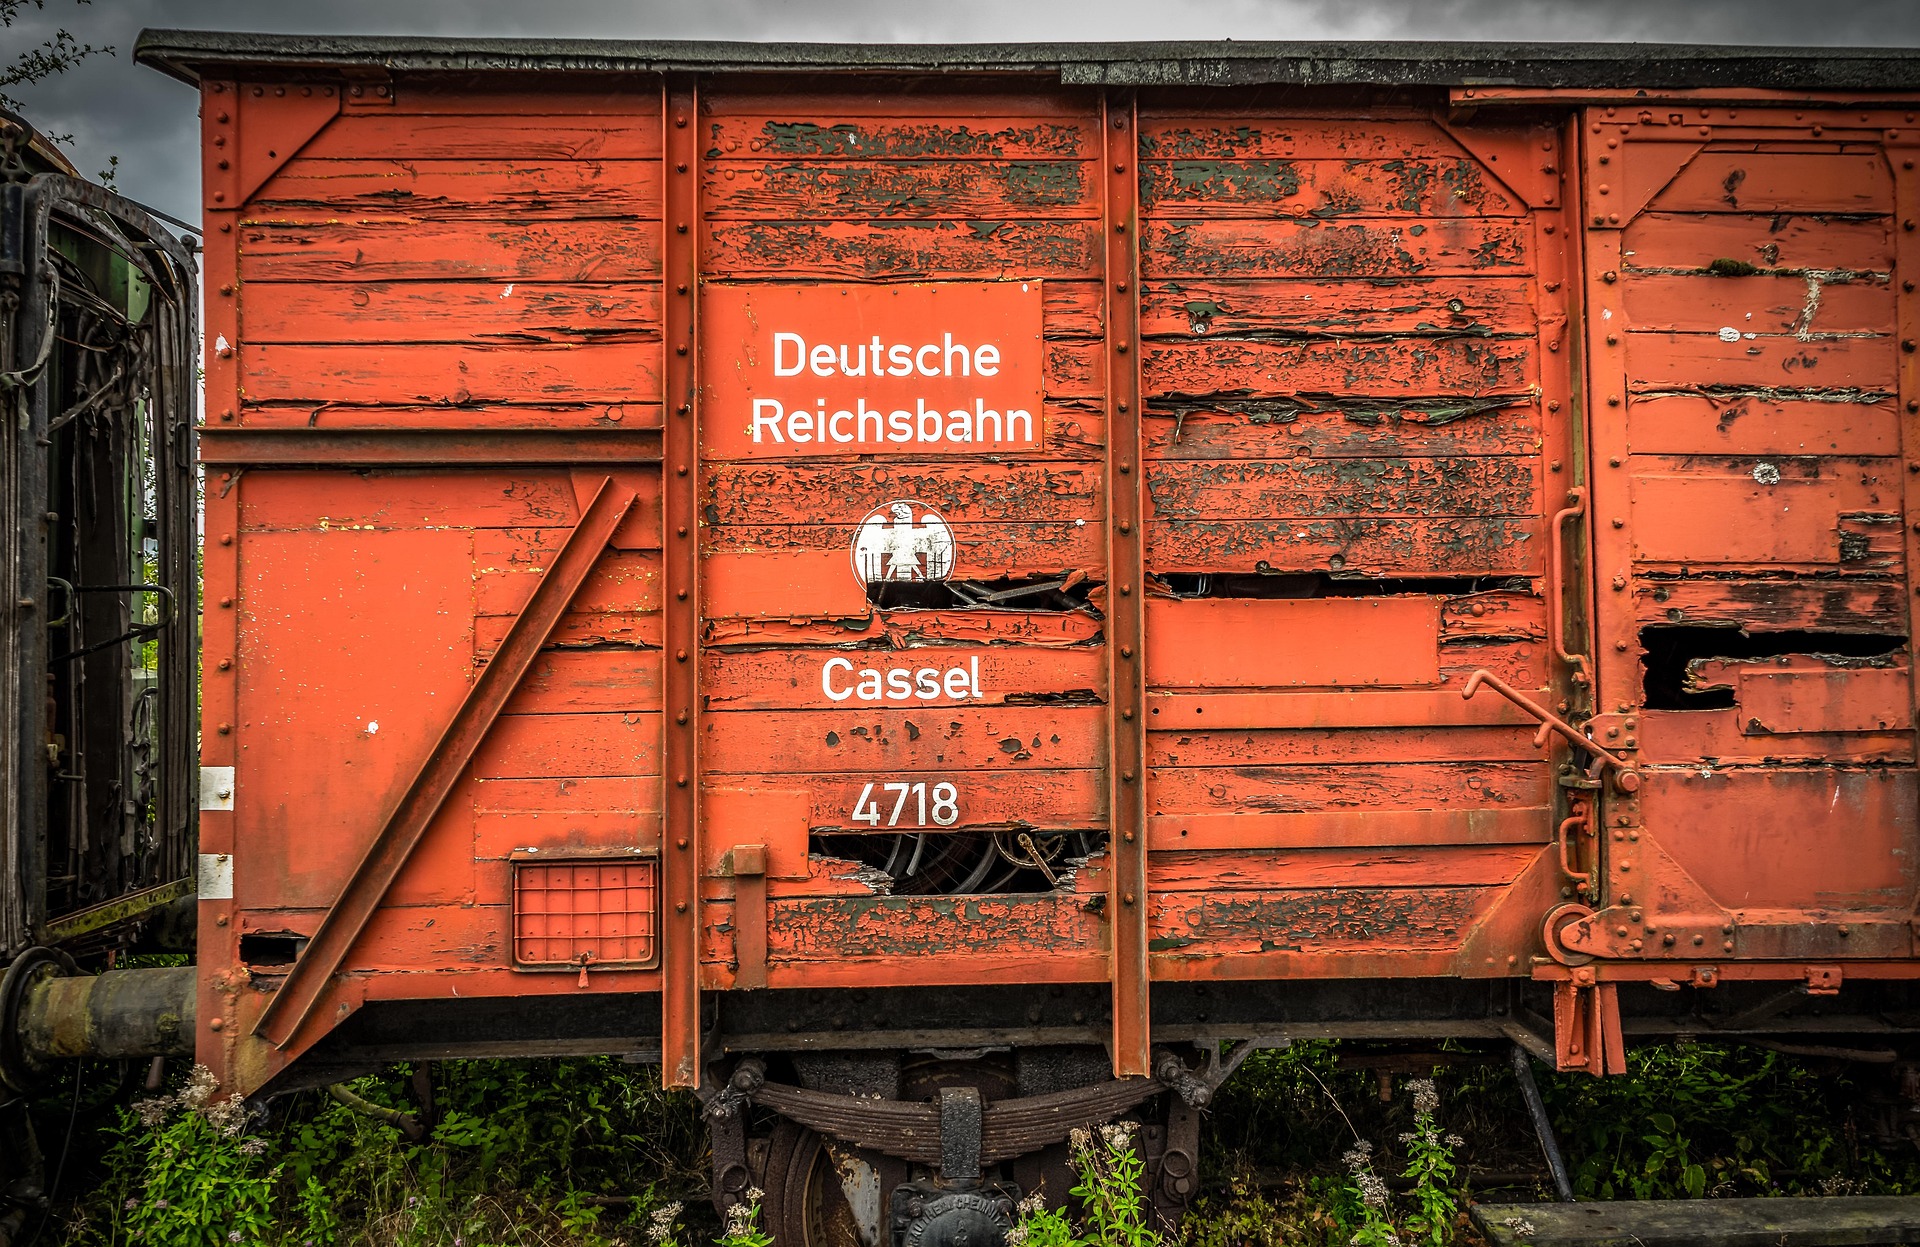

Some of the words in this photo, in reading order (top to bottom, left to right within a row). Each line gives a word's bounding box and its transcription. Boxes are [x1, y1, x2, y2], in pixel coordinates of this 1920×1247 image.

[773, 332, 1001, 377] Deutsche
[752, 398, 1034, 444] Reichsbahn
[821, 656, 984, 702] Cassel
[851, 781, 959, 827] 4718
